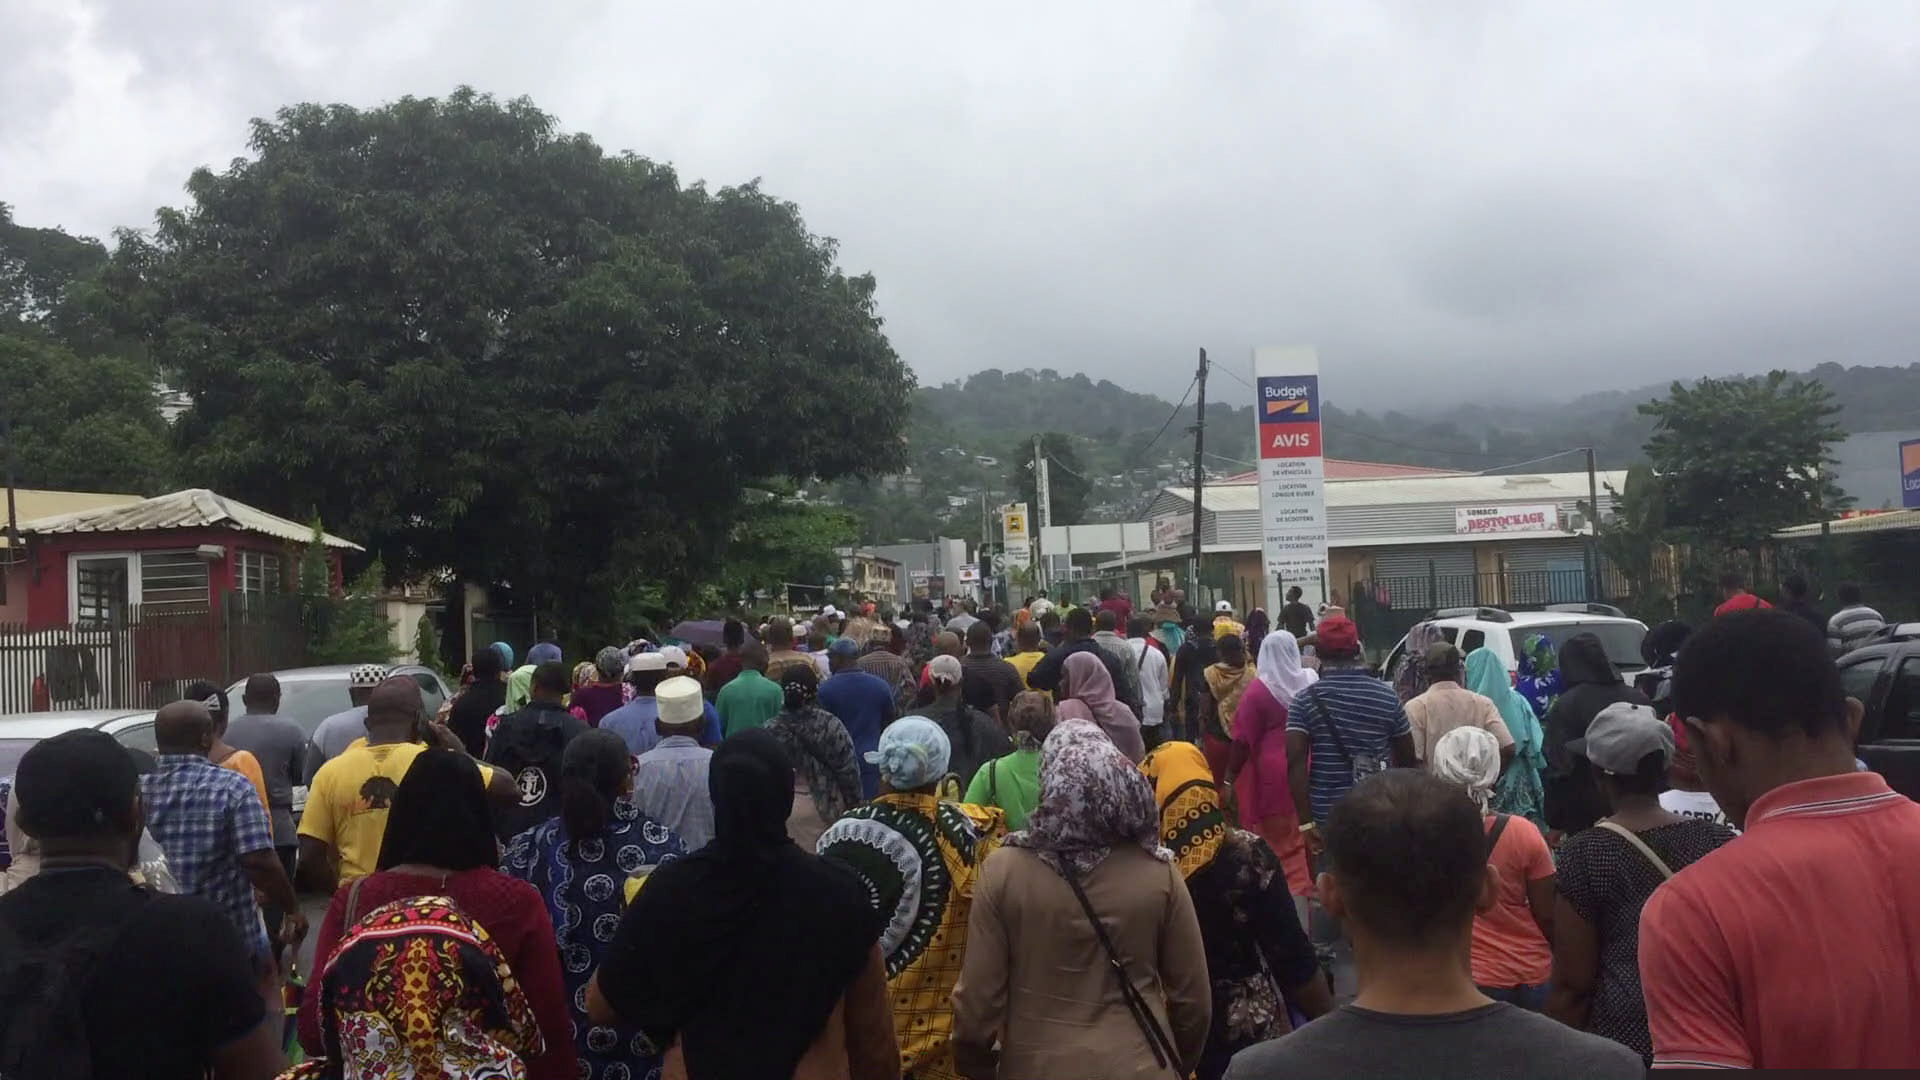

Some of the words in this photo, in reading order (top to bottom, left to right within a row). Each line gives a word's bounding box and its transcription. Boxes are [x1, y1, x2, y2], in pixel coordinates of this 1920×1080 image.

[1265, 386, 1308, 399] Budget
[1272, 433, 1310, 448] AVIS
[1467, 512, 1545, 530] DESTOCKAGE
